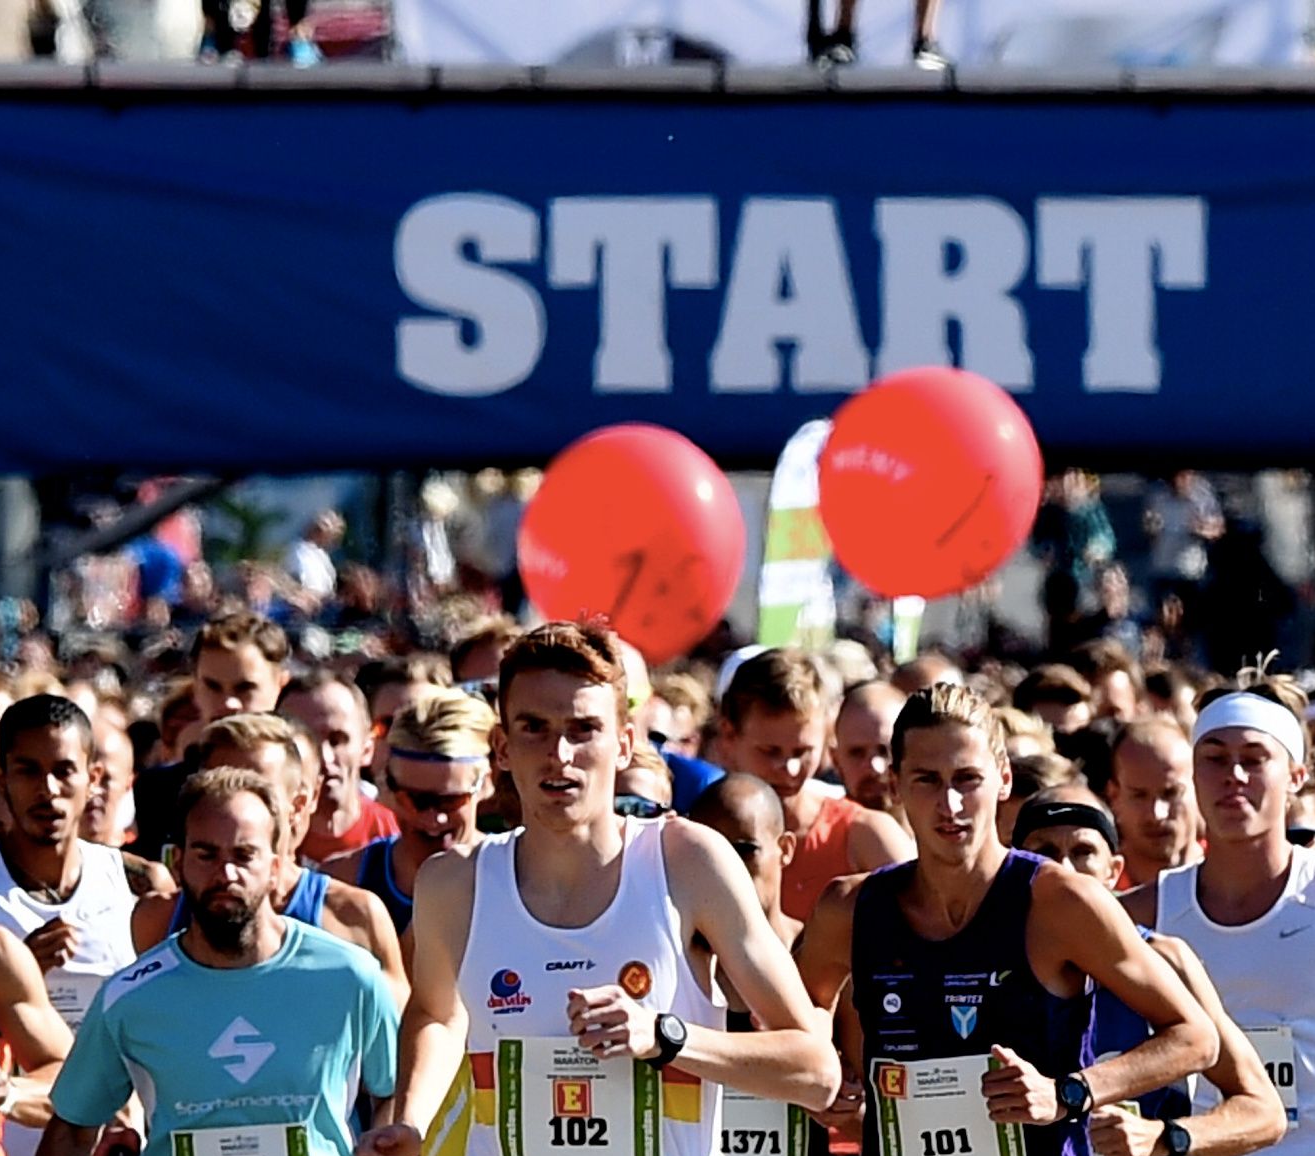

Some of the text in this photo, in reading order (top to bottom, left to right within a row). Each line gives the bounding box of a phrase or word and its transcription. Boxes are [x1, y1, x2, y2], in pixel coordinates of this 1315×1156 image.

[394, 193, 1210, 397] START
[545, 960, 585, 972] CRAFT
[548, 1115, 609, 1147] 102
[920, 1128, 973, 1156] 101
